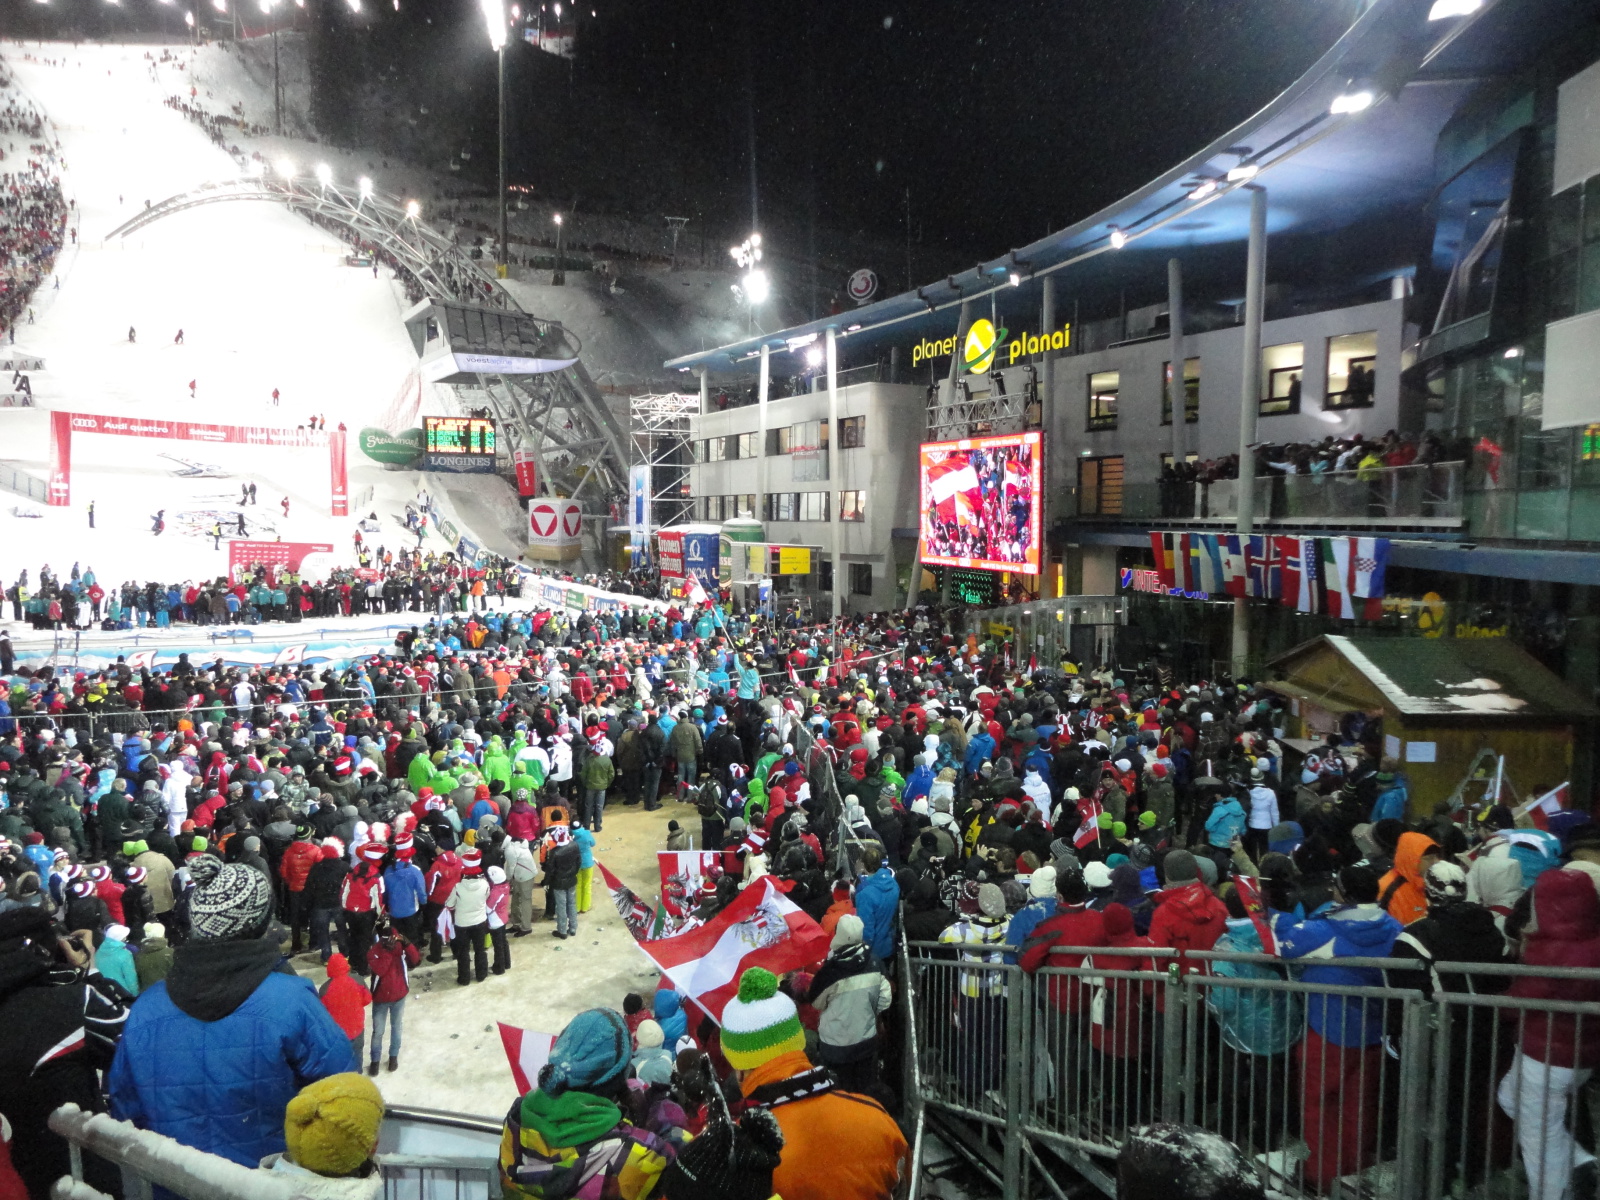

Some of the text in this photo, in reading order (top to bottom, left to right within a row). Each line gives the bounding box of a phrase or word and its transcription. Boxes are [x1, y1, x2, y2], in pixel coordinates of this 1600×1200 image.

[913, 334, 958, 367] planet
[1009, 323, 1070, 364] planai
[103, 422, 169, 433] Audi quattro
[430, 456, 491, 467] LONGINES
